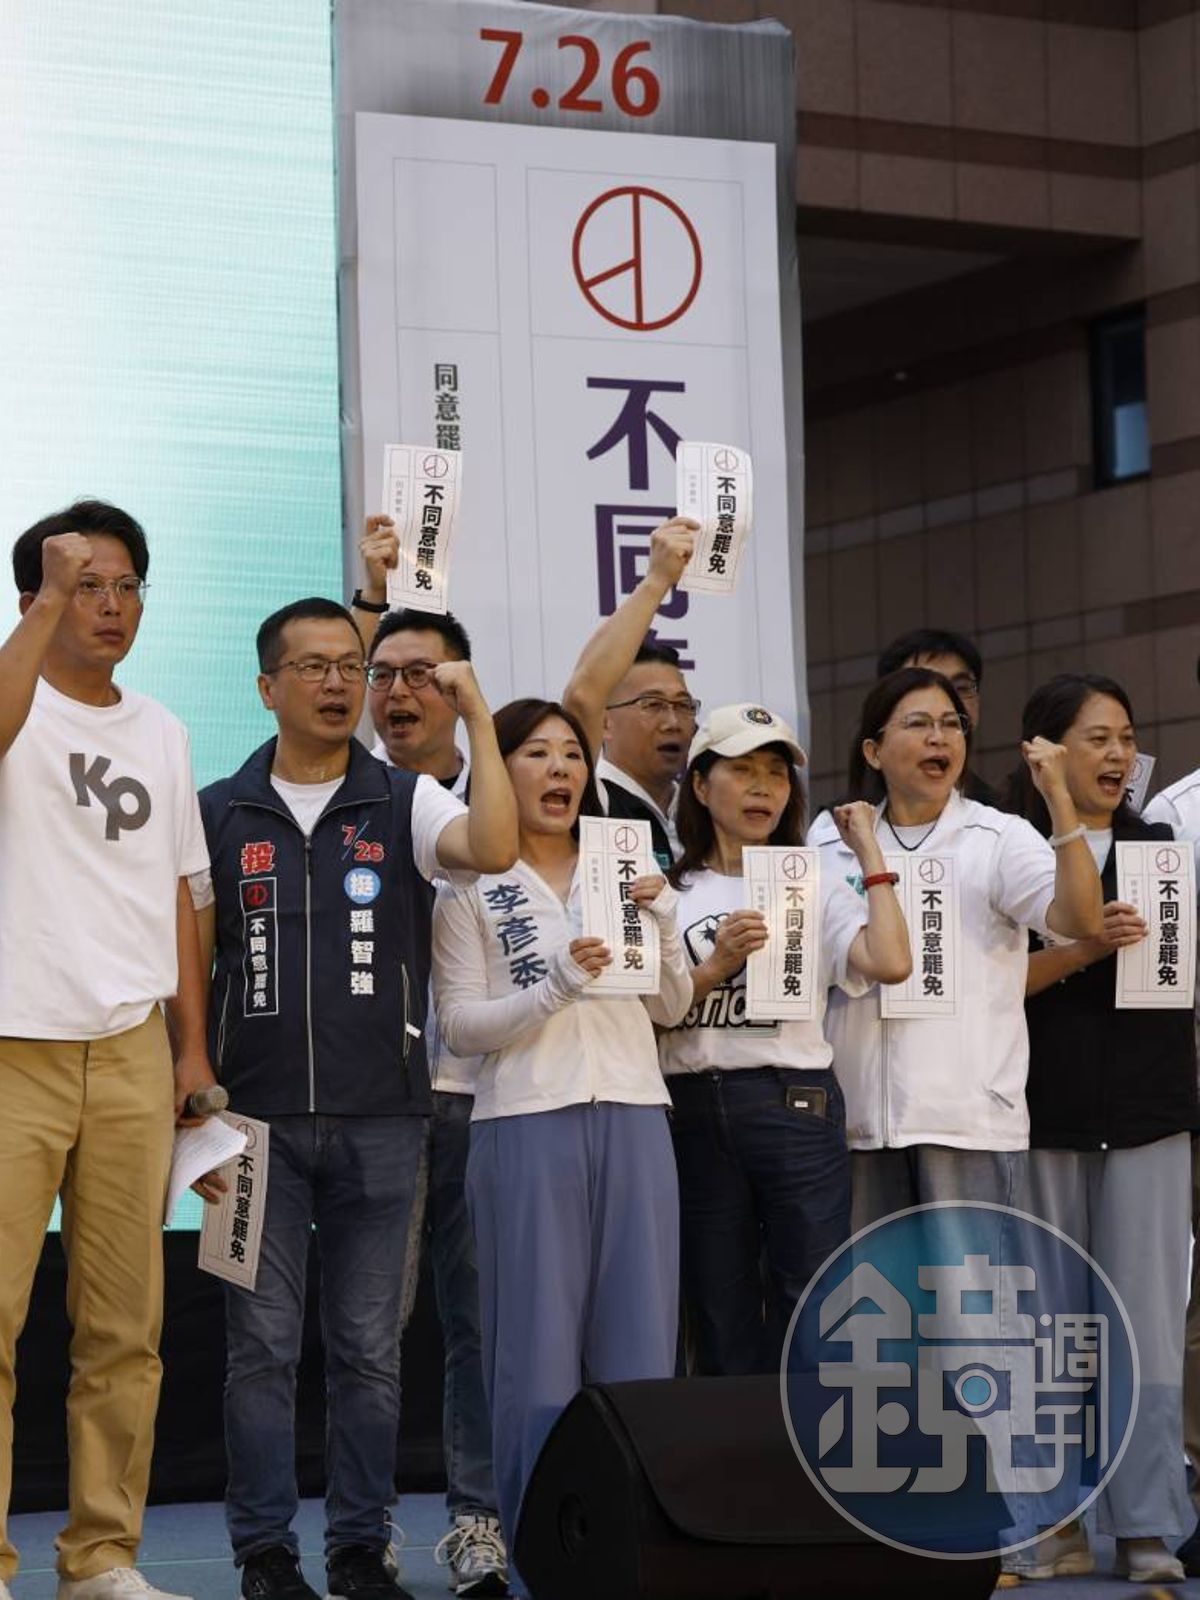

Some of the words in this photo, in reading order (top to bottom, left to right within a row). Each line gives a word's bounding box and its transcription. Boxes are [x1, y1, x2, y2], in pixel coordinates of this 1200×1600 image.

[479, 28, 662, 118] 7.26
[415, 484, 444, 591] 不同意罷免
[586, 376, 695, 671] 不同
[708, 476, 737, 574] 不同意罷免
[241, 842, 275, 875] 投
[250, 917, 268, 1008] 不同意罷免
[350, 909, 375, 996] 羅智強
[783, 886, 805, 996] 不同意罷免
[921, 889, 944, 996] 不同意罷免
[1157, 880, 1179, 986] 不同意罷免
[230, 1154, 254, 1264] 不同意罷免
